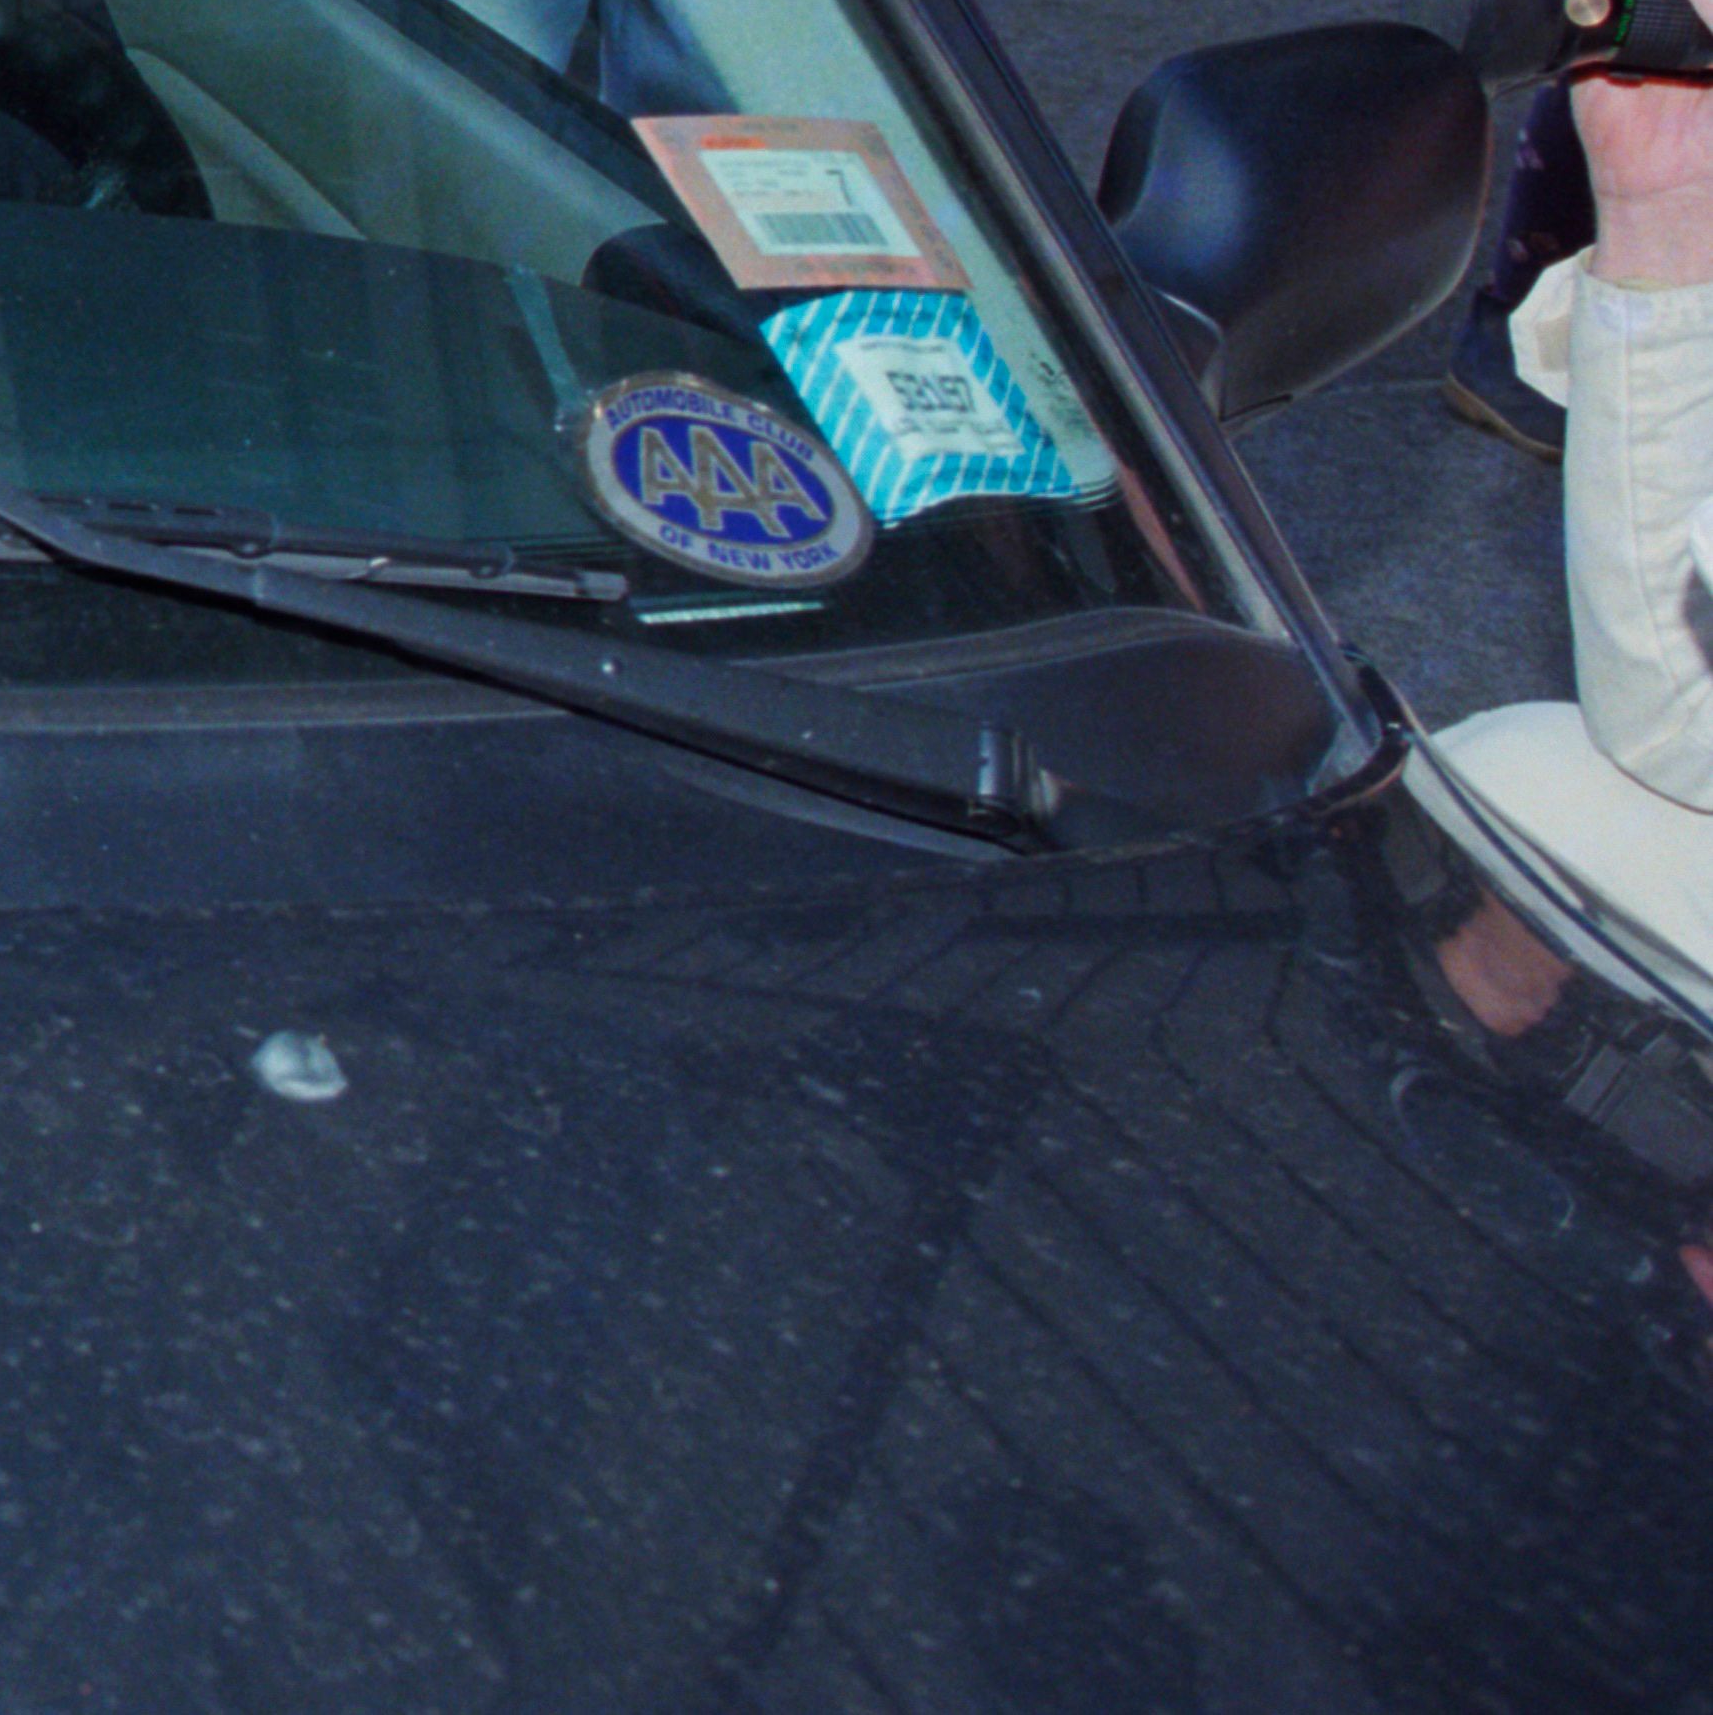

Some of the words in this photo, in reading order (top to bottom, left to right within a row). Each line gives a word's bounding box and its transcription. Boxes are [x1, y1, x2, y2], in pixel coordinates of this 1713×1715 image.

[604, 386, 737, 432] AUTOMOBILE
[745, 412, 815, 462] CLUB
[638, 424, 828, 539] AAA
[658, 522, 694, 549] OF
[707, 541, 773, 571] NEW
[777, 540, 841, 571] YORK
